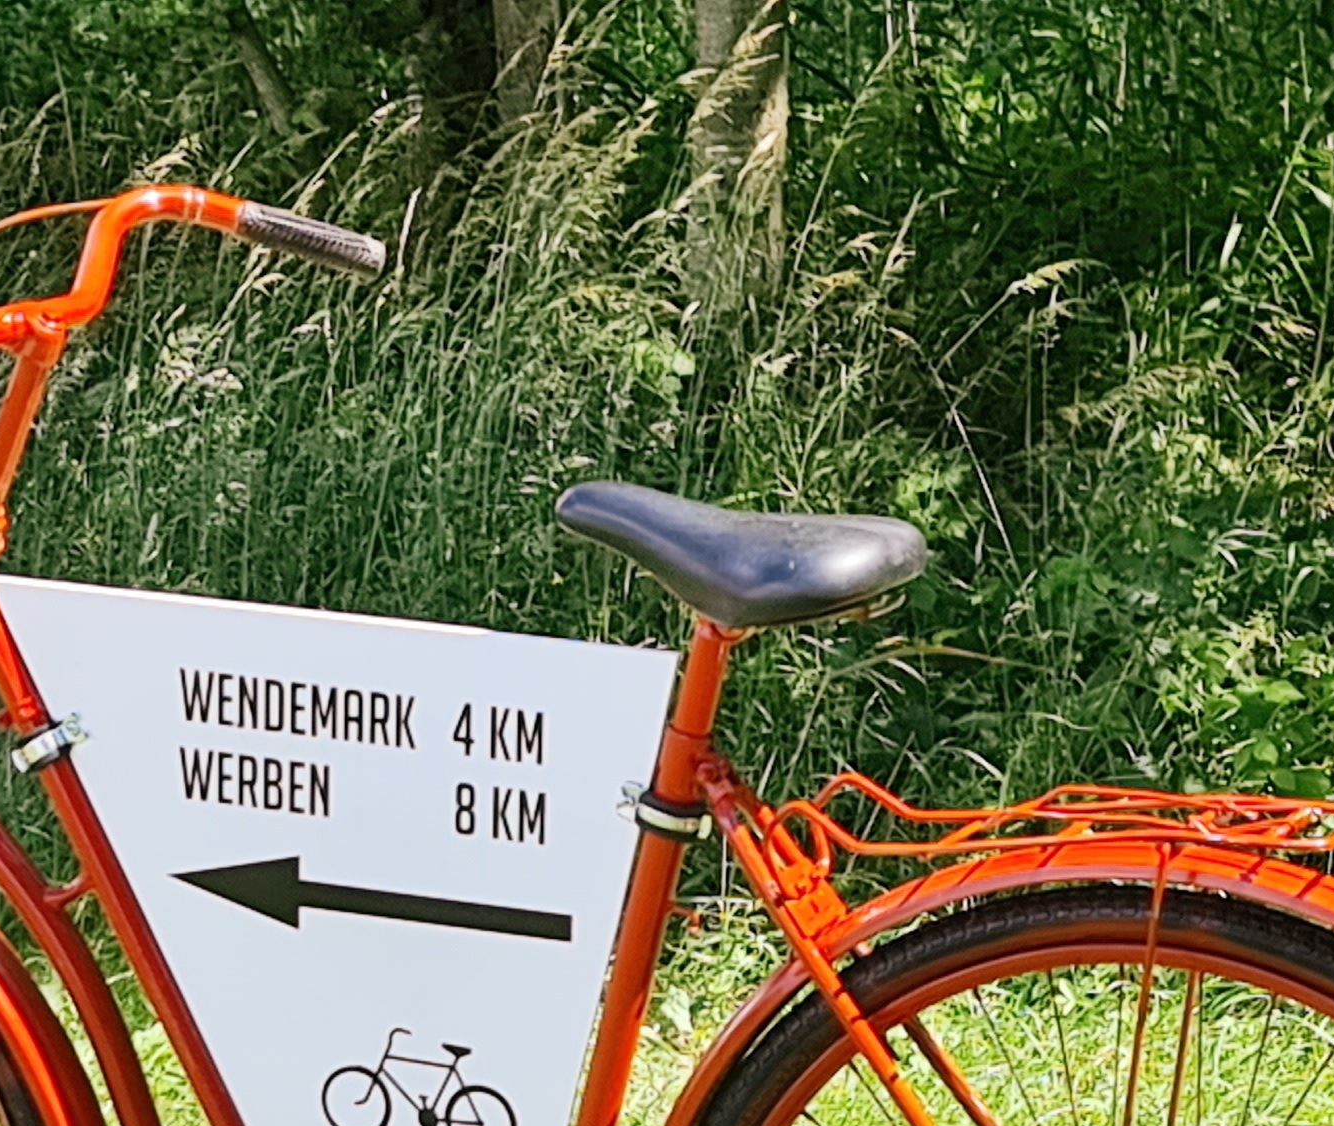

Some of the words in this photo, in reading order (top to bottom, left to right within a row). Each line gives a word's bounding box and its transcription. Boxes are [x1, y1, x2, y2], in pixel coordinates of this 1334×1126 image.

[180, 668, 415, 749] WENDEMARK
[453, 703, 475, 756] 4
[490, 706, 544, 765] KM
[179, 747, 331, 817] WERBEN
[454, 782, 476, 836] 8
[492, 786, 546, 845] KM
